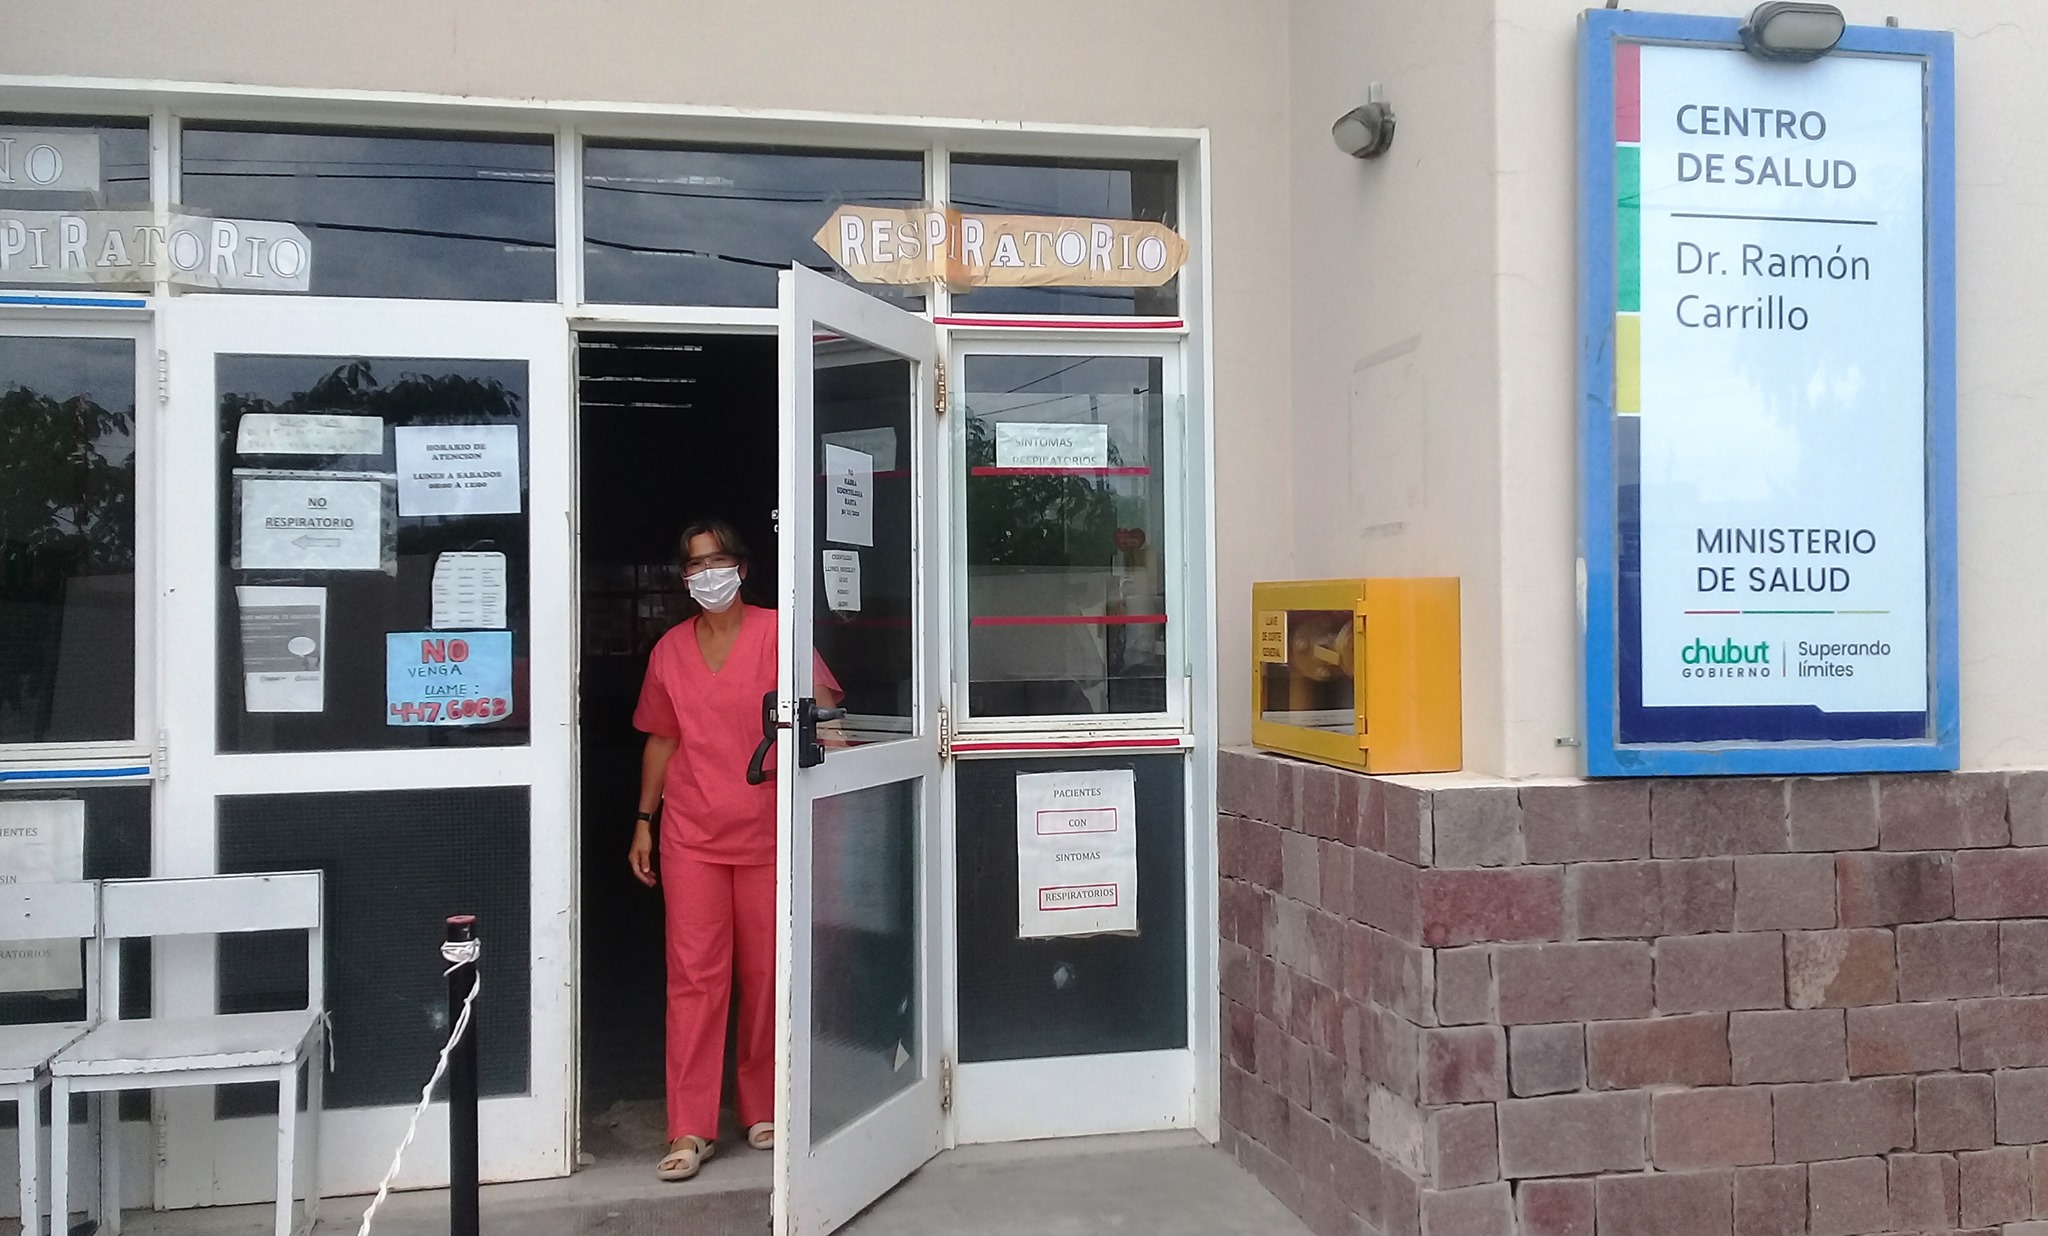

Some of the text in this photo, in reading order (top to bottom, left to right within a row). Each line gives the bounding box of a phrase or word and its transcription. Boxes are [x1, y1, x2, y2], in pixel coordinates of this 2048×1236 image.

[1677, 104, 1827, 140] CENTRO
[1677, 153, 1857, 189] DE SALUD
[839, 212, 1167, 273] RESPIRATORIO
[1676, 242, 1870, 281] Dr. Ramón
[1676, 294, 1809, 331] Carrillo
[473, 443, 486, 451] DE
[431, 452, 482, 461] ATENCION
[413, 472, 445, 480] LUNES
[457, 471, 502, 479] SABADOS
[308, 497, 328, 508] NO
[265, 516, 354, 528] RESPIRATORIO
[1696, 527, 1876, 555] MINISTERIO
[1697, 567, 1850, 593] DE SALUD
[421, 638, 469, 664] NO
[1681, 637, 1770, 665] chubut
[1798, 640, 1891, 661] Superando
[408, 664, 462, 678] VENGA
[1682, 667, 1770, 678] GOBIERNO
[1798, 660, 1854, 677] límites
[1053, 787, 1102, 799] PACIENTES
[1068, 818, 1087, 828] CON
[1055, 851, 1101, 862] SINTOMAS
[1045, 888, 1115, 902] RESPIRATORIOS
